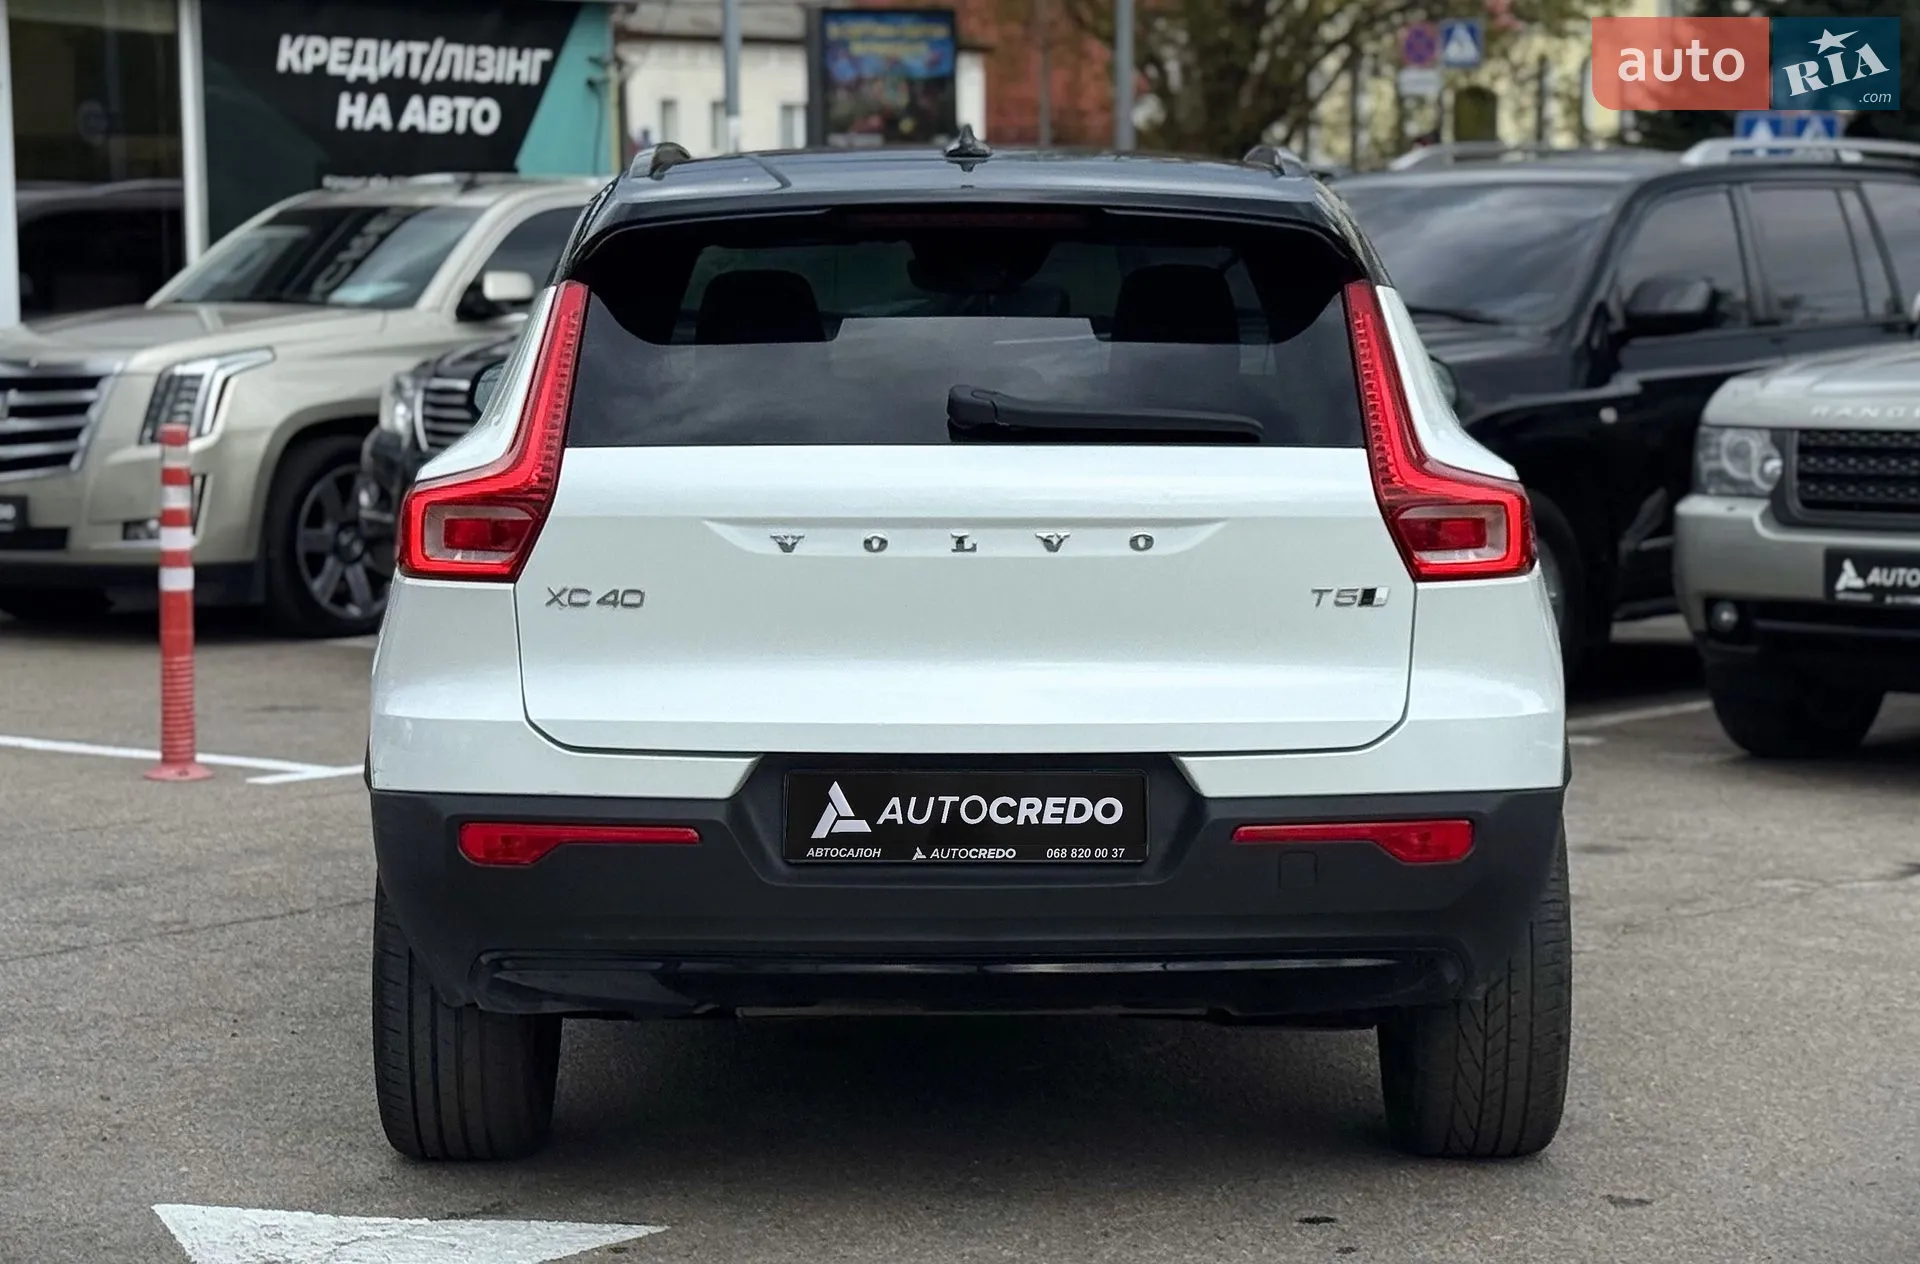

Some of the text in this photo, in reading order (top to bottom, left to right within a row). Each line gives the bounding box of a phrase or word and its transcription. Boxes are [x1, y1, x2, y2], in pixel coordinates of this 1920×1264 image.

[276, 33, 553, 85] КРЕДИТ/ЛІЗІНГ
[335, 91, 502, 136] НА АВТО
[769, 531, 1155, 554] VOLVO
[1310, 587, 1360, 608] T5
[876, 795, 1124, 825] AUTOCREDO
[806, 847, 882, 858] АВТОСАЛОН
[929, 848, 1017, 859] AUTOCREDO
[1046, 847, 1126, 859] 068 820 00 37
